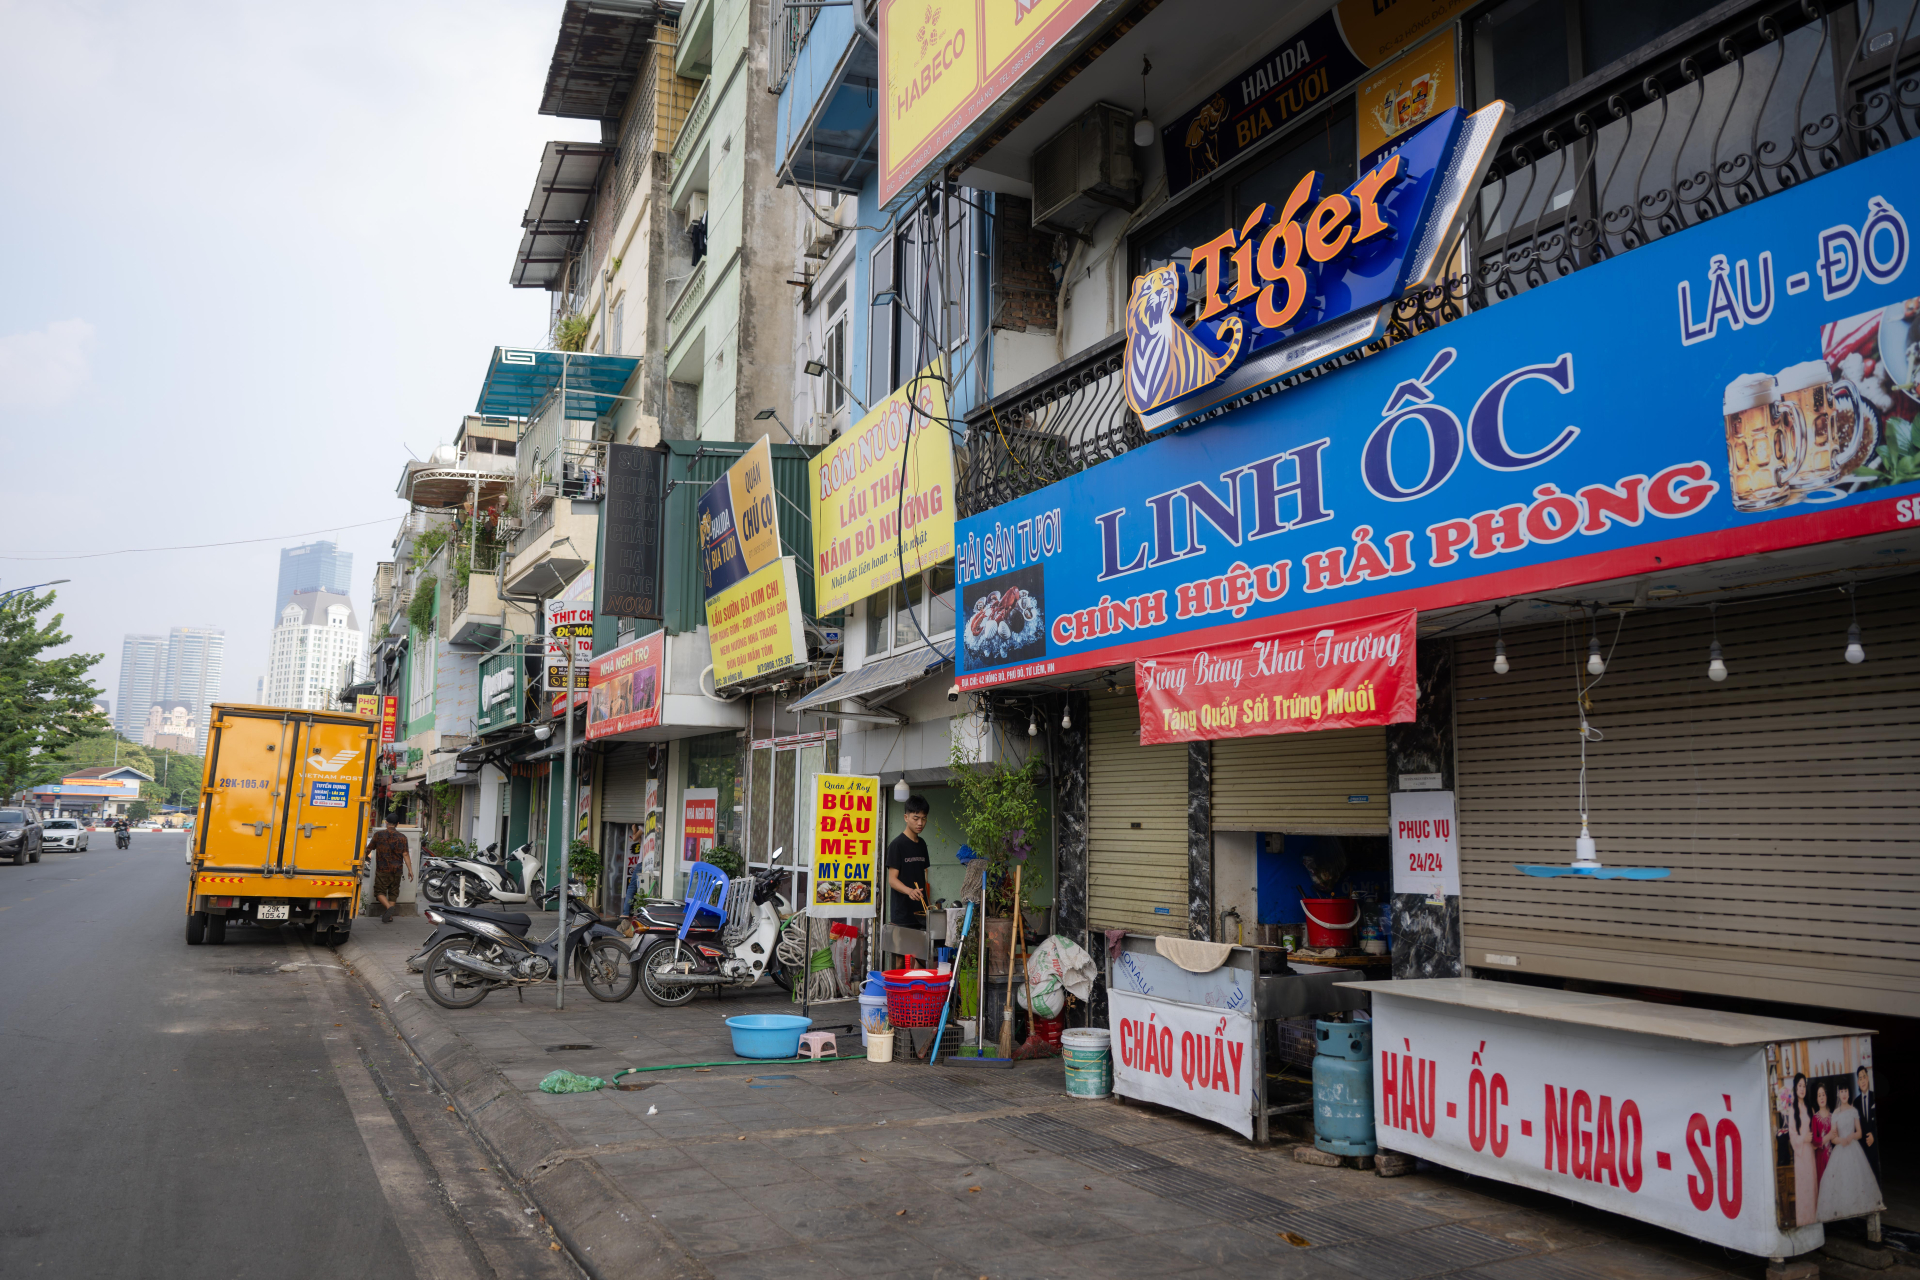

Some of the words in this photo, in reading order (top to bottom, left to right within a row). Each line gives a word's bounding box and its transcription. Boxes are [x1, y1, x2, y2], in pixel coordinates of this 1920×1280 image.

[898, 28, 965, 121] HABECO
[1241, 39, 1311, 106] HALIDA
[1236, 107, 1273, 148] BIA
[1275, 67, 1329, 120] TƯƠI
[1189, 154, 1401, 329] Tiger
[1678, 252, 1774, 347] LẨU
[1817, 195, 1910, 302] ĐỒ
[819, 442, 857, 502] RƠM
[1095, 437, 1334, 582] LINH
[1361, 347, 1580, 502] ỐC
[611, 474, 658, 497] CHUA
[839, 485, 867, 529] LẨU
[870, 460, 909, 509] THÁI
[711, 508, 731, 540] HALIDA
[742, 496, 760, 542] CHÚ
[761, 493, 773, 535] CỌ
[820, 537, 852, 577] NẦM
[854, 518, 875, 558] BÒ
[879, 484, 943, 544] NƯỚNG
[620, 549, 644, 573] HẠ
[711, 546, 722, 571] BIA
[957, 532, 980, 584] HẢI
[983, 521, 1015, 576] SẢN
[1017, 507, 1062, 565] TƯƠI
[1051, 595, 1168, 646] CHÍNH
[1175, 561, 1292, 618] HIỆU
[1302, 525, 1415, 593] HẢI
[1426, 460, 1720, 568] PHÒNG
[607, 572, 653, 595] LONG
[831, 570, 847, 590] Nhận
[847, 565, 858, 584] đặt
[858, 560, 871, 577] liên
[871, 555, 888, 570] hoan
[606, 594, 652, 615] NOW
[740, 592, 750, 613] BÒ
[751, 587, 765, 608] KIM
[766, 579, 779, 601] CHI
[552, 609, 577, 625] THỊT
[579, 609, 594, 622] CH
[759, 623, 778, 641] TRANG
[600, 657, 614, 677] NHÀ
[615, 647, 634, 671] NGHỈ
[634, 645, 650, 664] TRỌ
[1192, 651, 1244, 689] Bừng
[1248, 638, 1306, 679] Khai
[358, 697, 377, 705] PHỞ
[1162, 708, 1197, 736] Tặng
[1200, 696, 1238, 729] Quẩy
[1242, 693, 1269, 725] Sốt
[1273, 692, 1321, 721] Trứng
[1327, 679, 1376, 715] Muối
[299, 772, 338, 780] VIETNAM
[824, 781, 845, 790] Quán
[822, 791, 873, 812] BÚN
[820, 813, 871, 836] ĐẬU
[1398, 819, 1431, 843] PHỤC
[1433, 819, 1450, 843] VỤ
[820, 838, 872, 859] MẸT
[1409, 853, 1443, 872] 24/24
[818, 859, 841, 879] MỲ
[844, 862, 870, 879] CAY
[261, 912, 286, 920] 105.47
[266, 905, 281, 913] 29K
[1119, 1013, 1174, 1079] CHÁO
[1181, 1016, 1245, 1096] QUẨY
[1381, 1037, 1436, 1140] HÀU
[1467, 1040, 1509, 1158] ỐC
[1544, 1082, 1643, 1194] NGAO
[1685, 1094, 1743, 1220] SÒ
